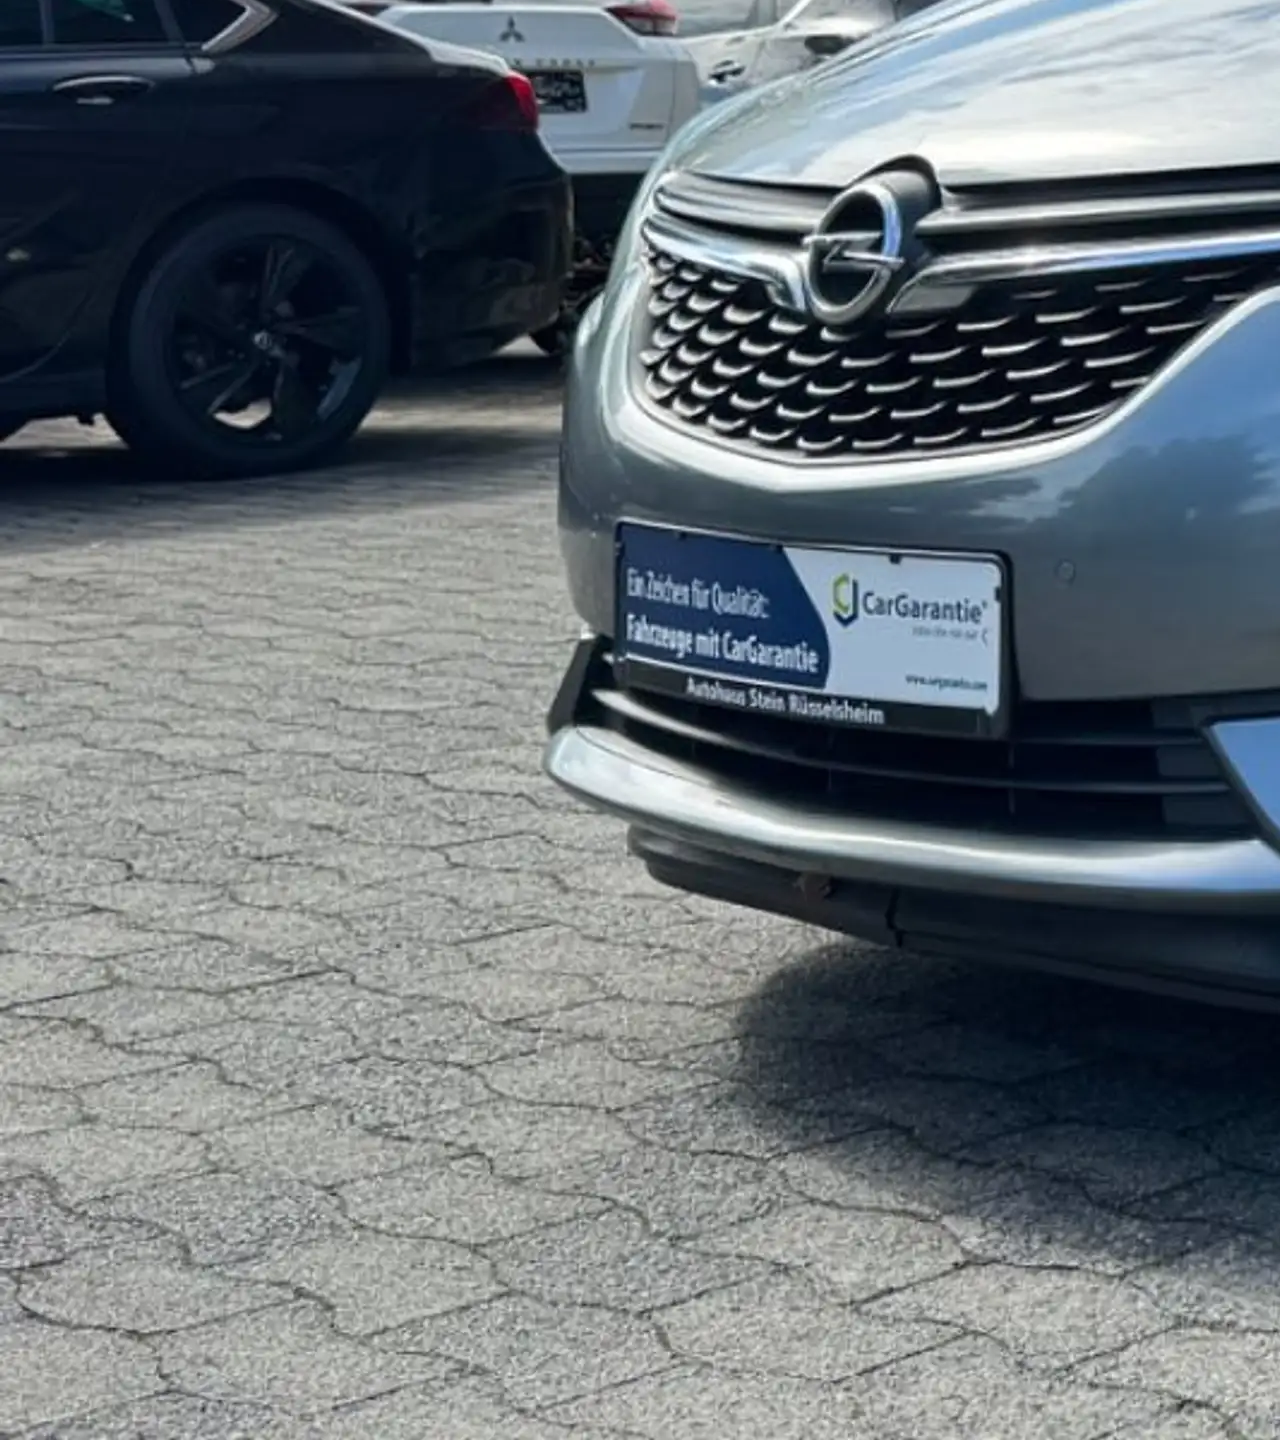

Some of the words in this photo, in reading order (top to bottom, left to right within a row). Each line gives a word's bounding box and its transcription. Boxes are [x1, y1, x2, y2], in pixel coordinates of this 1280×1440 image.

[627, 567, 645, 598] Ein
[646, 570, 689, 606] Zeichen
[691, 576, 709, 610] für
[627, 612, 692, 659] Fahrzeuge
[695, 627, 720, 659] mit
[722, 630, 819, 674] CarGarantie
[686, 675, 746, 707] Autohaus
[750, 687, 786, 712] Stein
[788, 692, 886, 725] Rüsselsheim
